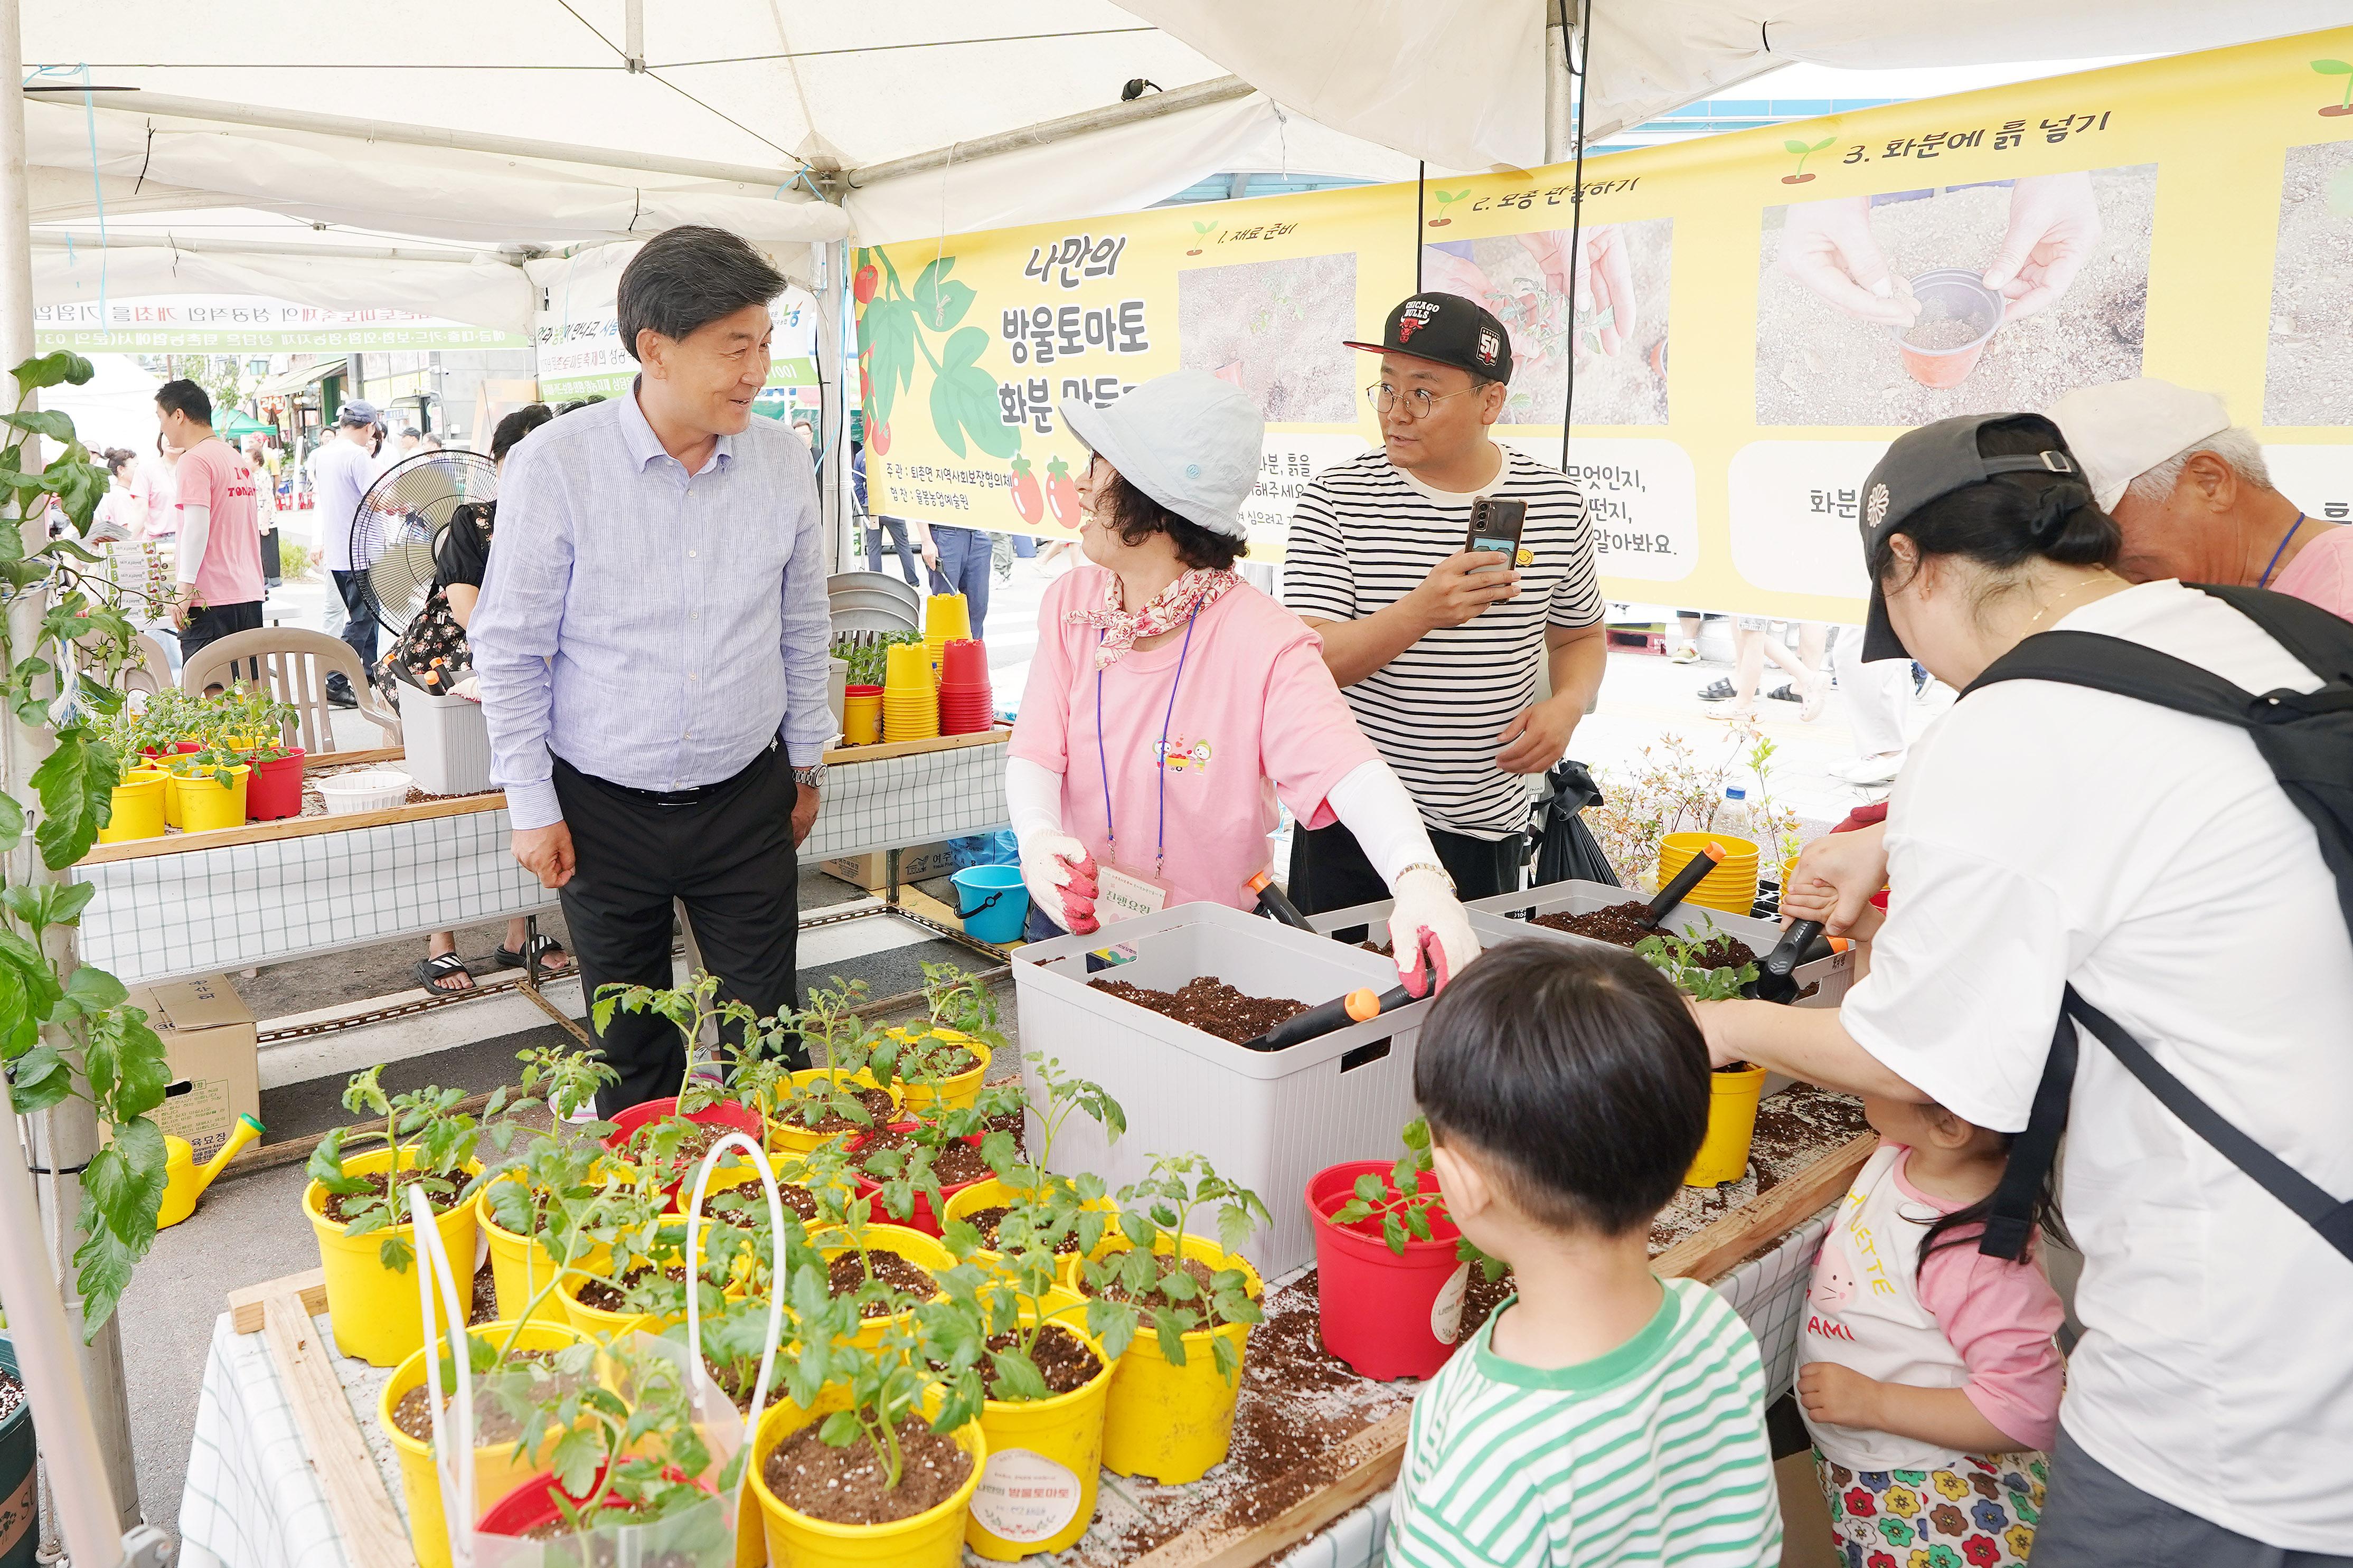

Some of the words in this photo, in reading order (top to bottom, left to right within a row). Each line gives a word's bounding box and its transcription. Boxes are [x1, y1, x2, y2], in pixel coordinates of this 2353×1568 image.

[1843, 145, 1870, 164] 3.
[1882, 129, 1984, 159] 화분에
[1994, 119, 2027, 150] 흙
[2039, 111, 2112, 144] 넣기
[1473, 197, 1490, 211] 2.
[1498, 190, 1539, 210] 모종
[1217, 231, 1228, 244] 1.
[1230, 227, 1264, 241] 재료
[1264, 223, 1298, 240] 준비
[1025, 237, 1125, 288] 나만의
[1404, 308, 1430, 319] BULLS
[1405, 301, 1441, 313] CHICAGO
[1003, 301, 1149, 364] 방울토마토
[1480, 334, 1499, 358] 50
[999, 377, 1052, 433] 화분
[911, 465, 933, 482] 퇴촌면
[936, 467, 1013, 488] 지역사회보장협의체
[1287, 454, 1311, 477] 흙을
[1810, 489, 1857, 519] 화분
[1248, 511, 1284, 525] 심으려고
[1593, 528, 1678, 555] 알아봐요.
[1106, 890, 1150, 915] 진행요원
[191, 1132, 227, 1147] 육묘장
[1009, 1487, 1069, 1499] 방울토마토
